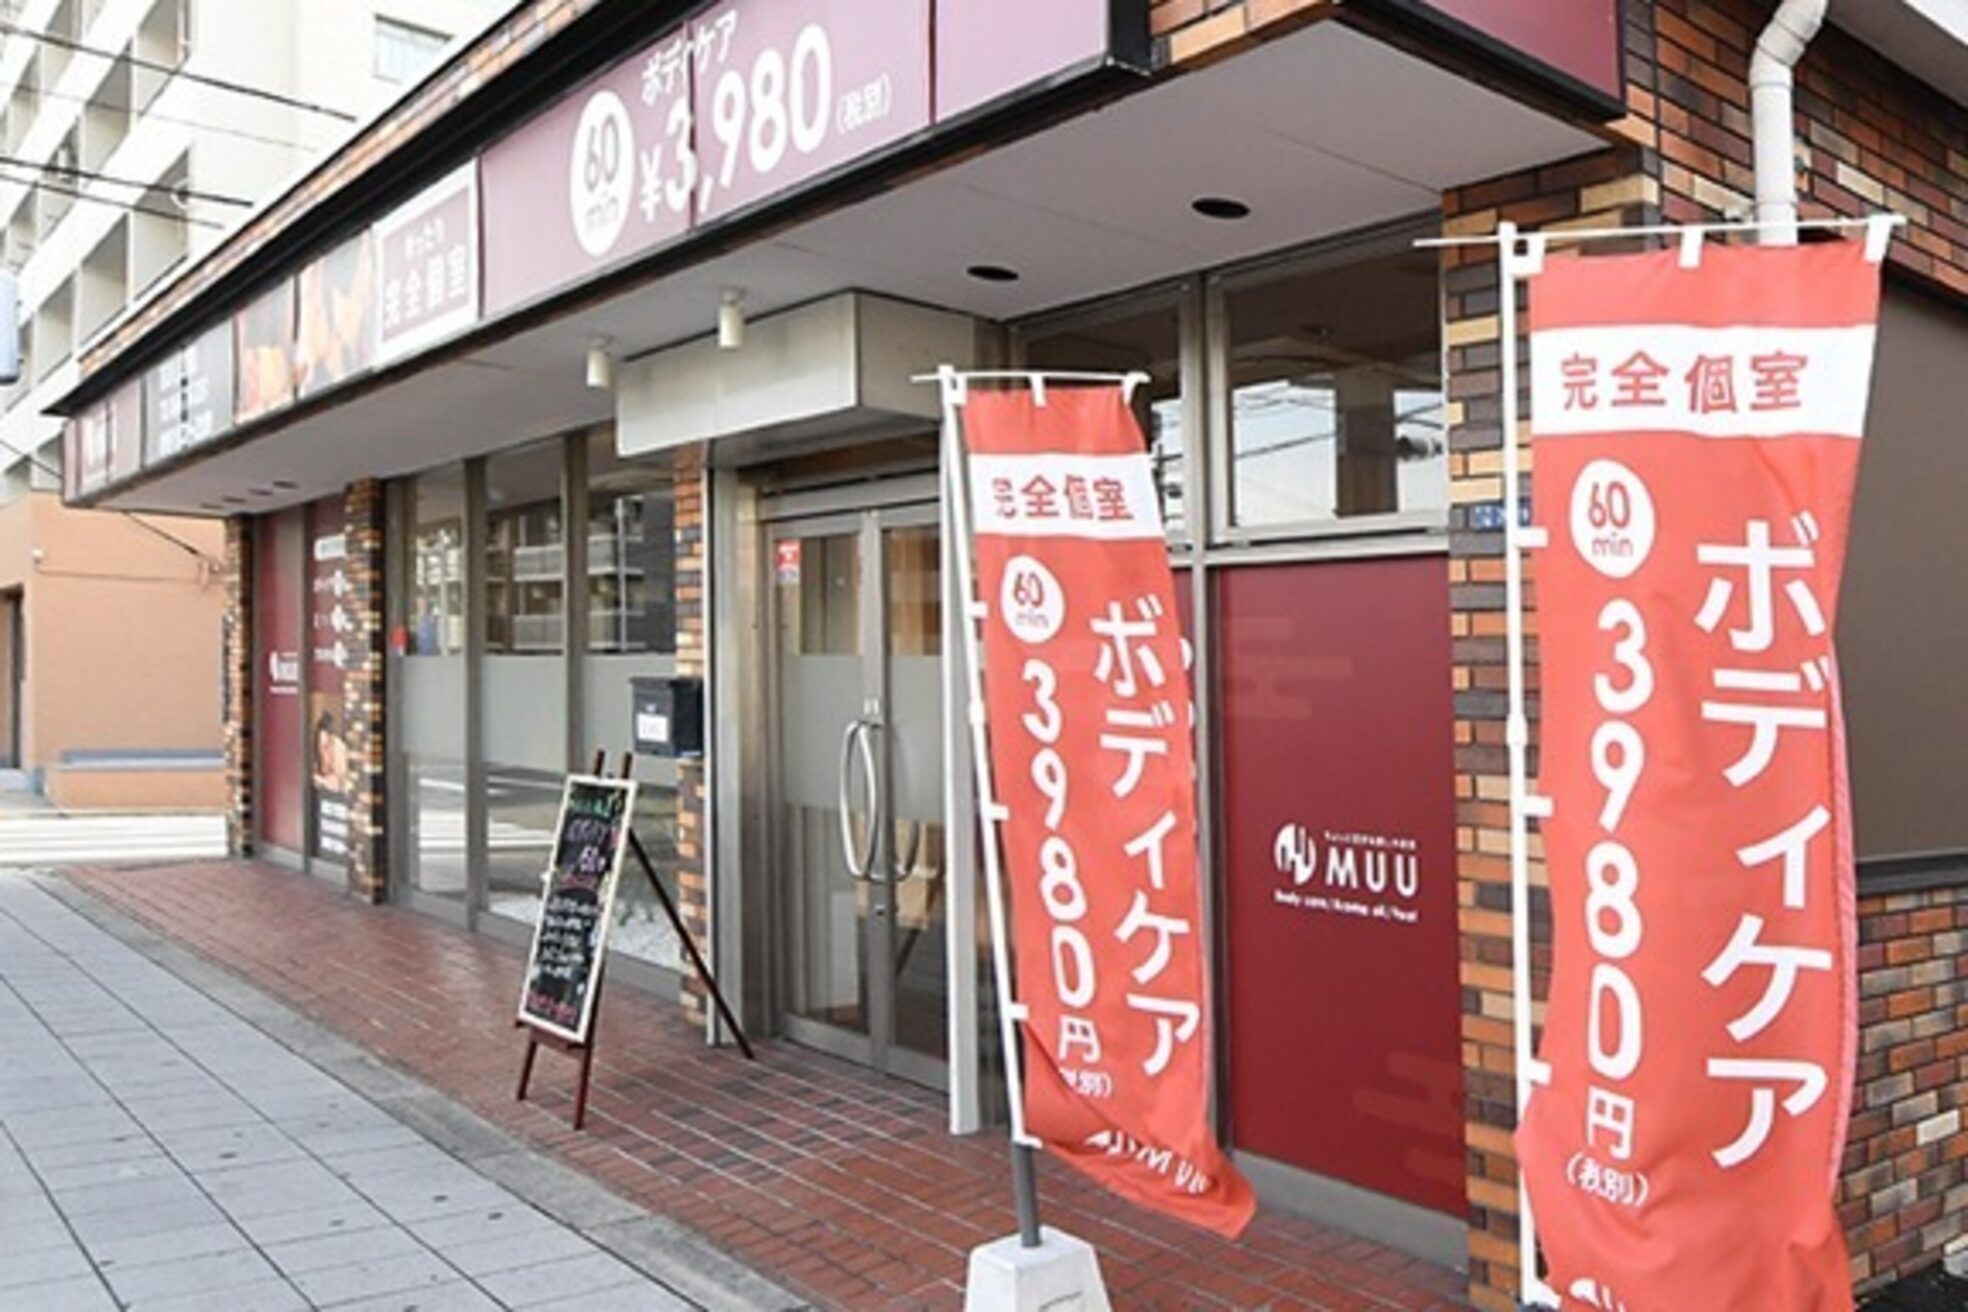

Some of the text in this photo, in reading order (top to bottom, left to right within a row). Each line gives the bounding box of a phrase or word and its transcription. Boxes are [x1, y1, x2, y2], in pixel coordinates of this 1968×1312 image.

[583, 113, 620, 194] 60
[1561, 350, 1808, 413] 完全個室
[992, 473, 1135, 522] 完全個室
[1588, 481, 1632, 529] 60
[1592, 532, 1634, 558] min
[1013, 571, 1044, 608] 60
[1088, 593, 1201, 1078] ボディケア
[1694, 511, 1834, 1168] ボディケア
[1324, 845, 1418, 898] MUU
